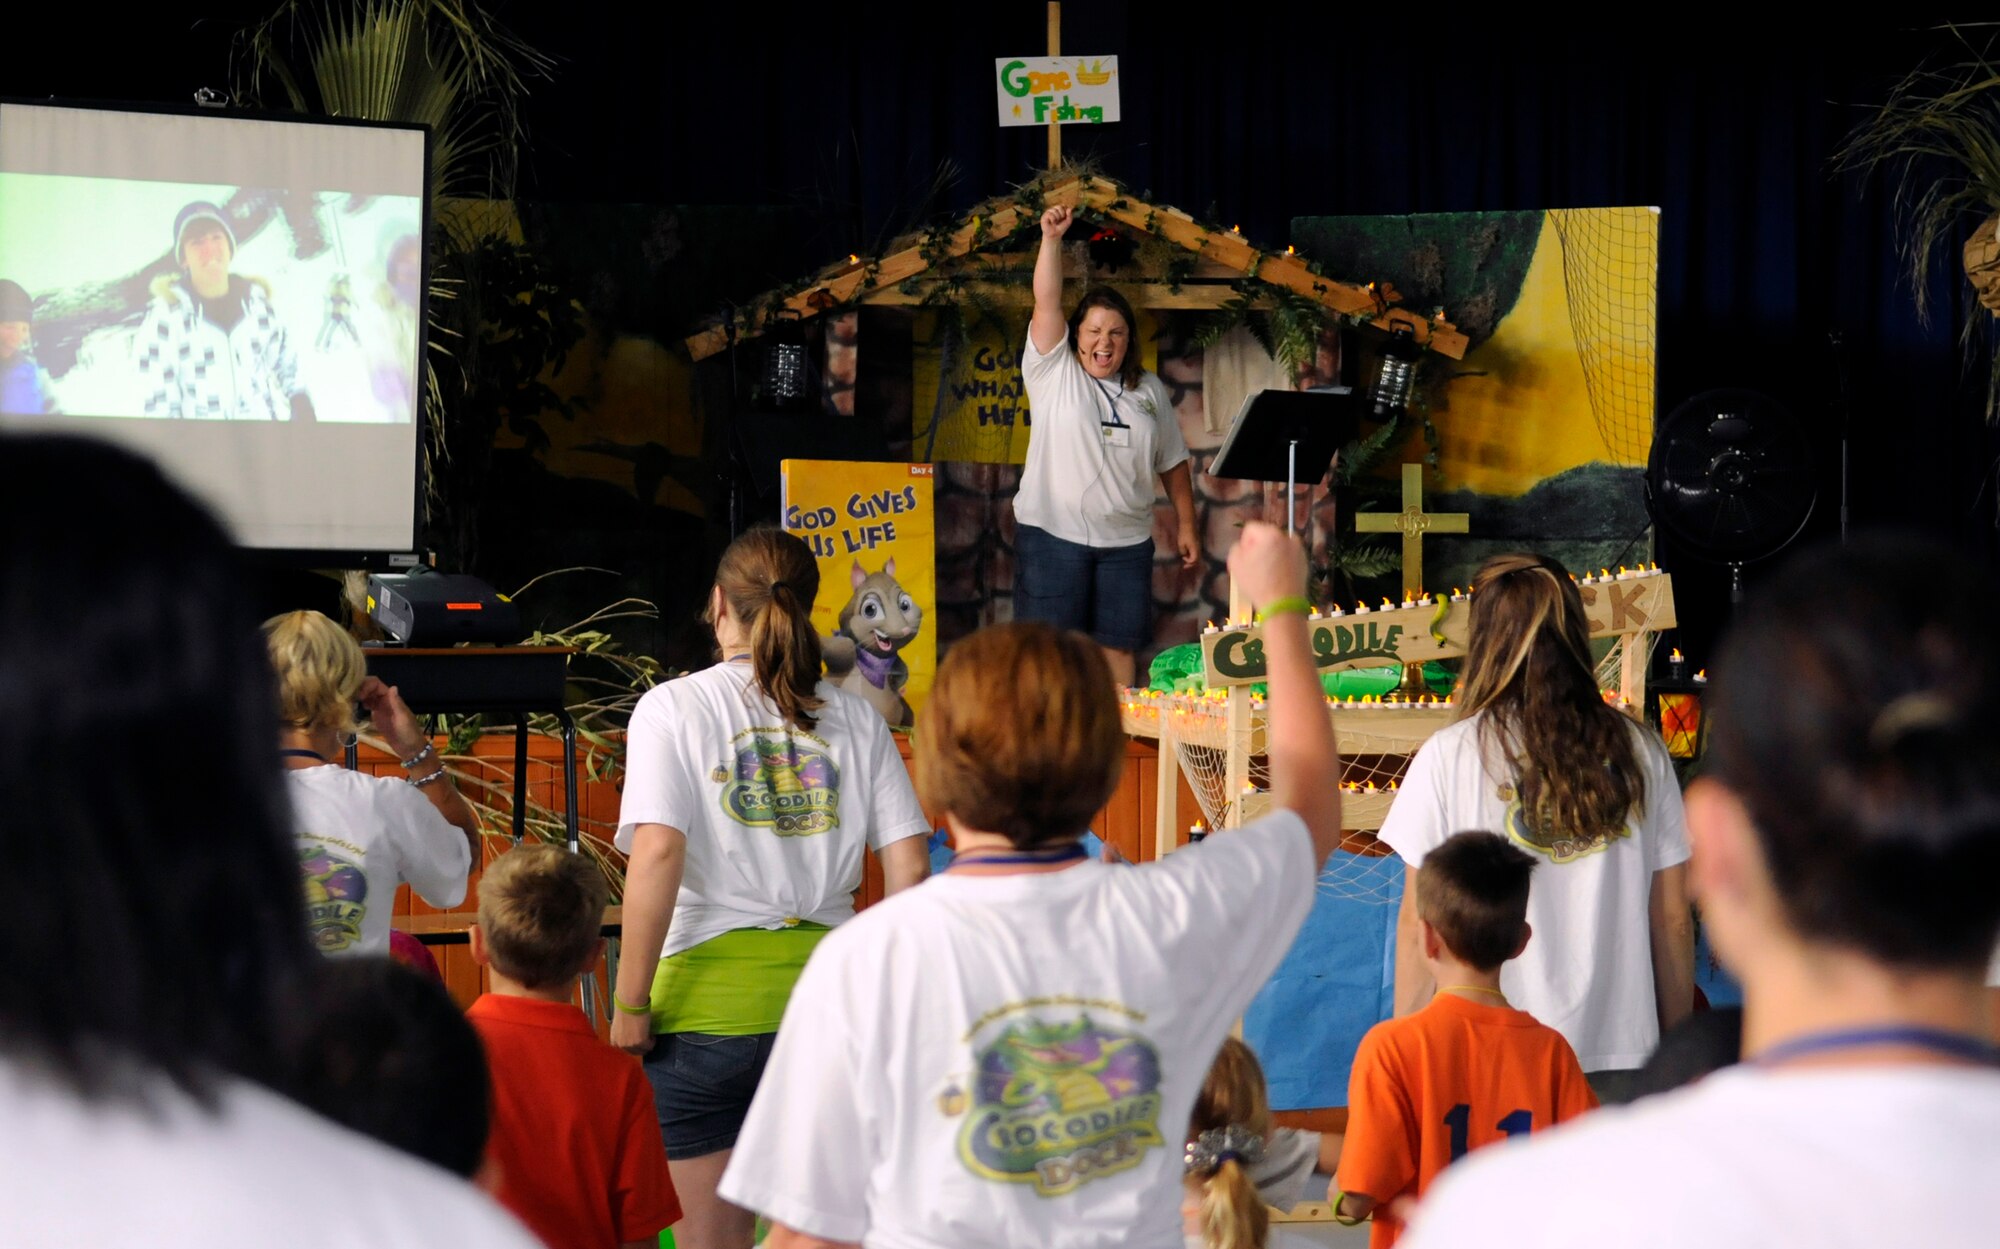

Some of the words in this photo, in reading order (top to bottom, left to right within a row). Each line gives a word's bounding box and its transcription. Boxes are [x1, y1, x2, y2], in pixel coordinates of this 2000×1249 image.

[1001, 60, 1072, 98] Gone
[1033, 95, 1103, 124] Fishing
[911, 466, 927, 475] DAY
[786, 505, 837, 530] GOD
[846, 485, 917, 520] GIVES
[802, 534, 836, 558] US
[842, 521, 896, 554] LIFE
[1213, 621, 1404, 679] CRODILE
